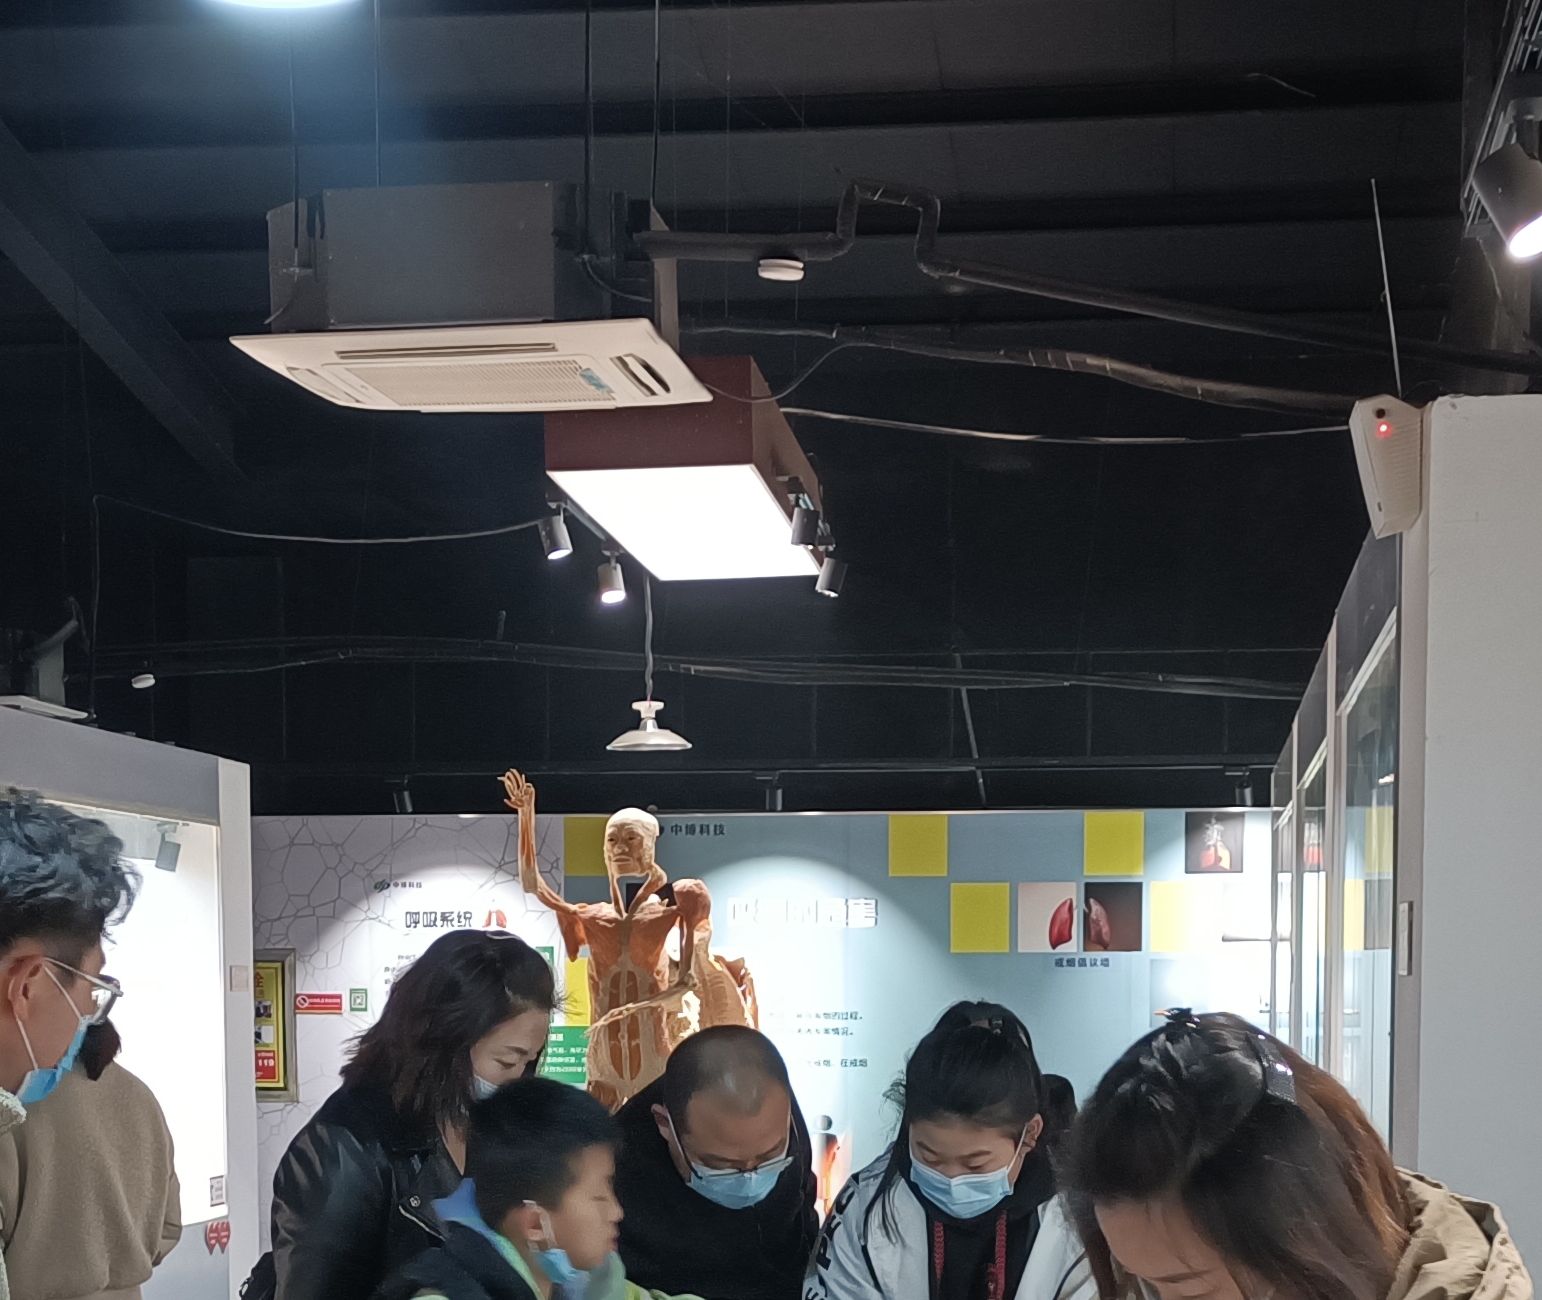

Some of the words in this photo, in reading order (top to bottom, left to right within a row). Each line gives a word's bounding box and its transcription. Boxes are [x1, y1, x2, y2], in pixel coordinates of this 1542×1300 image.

[670, 823, 726, 836] 中博科技
[405, 911, 473, 928] 呼吸系统
[258, 1059, 274, 1067] 119
